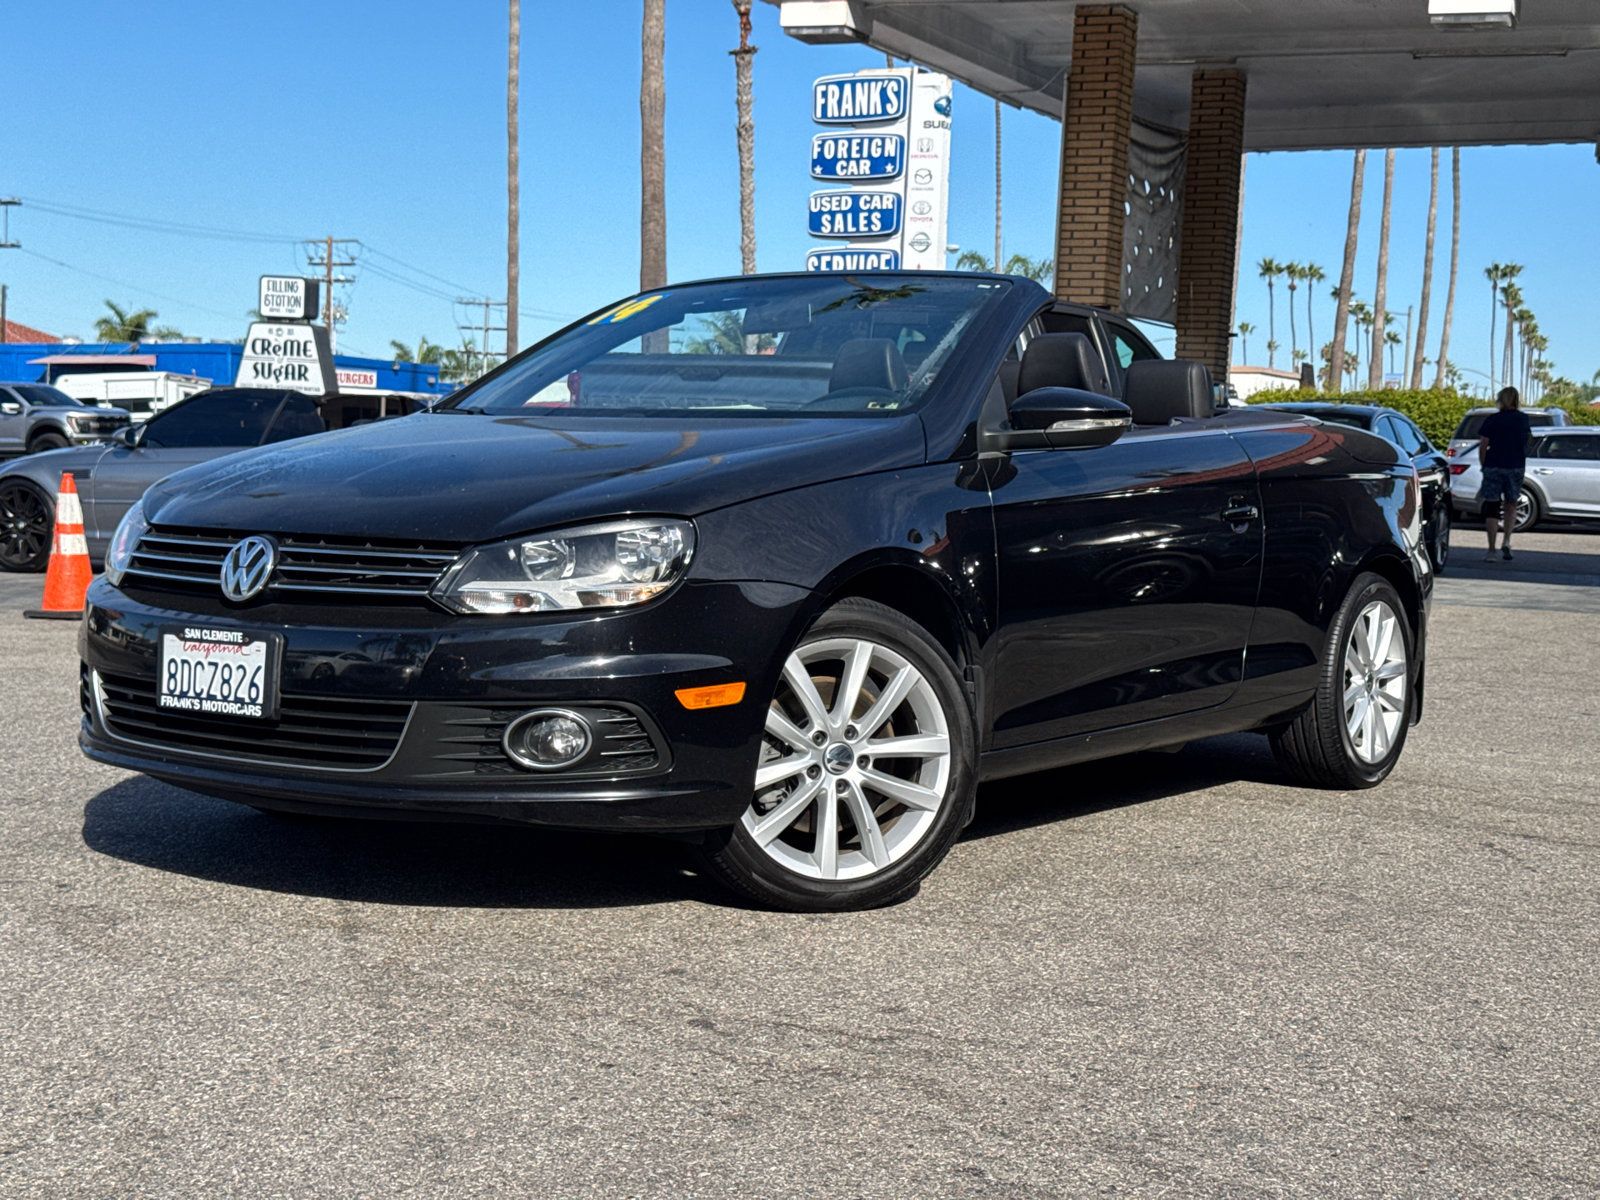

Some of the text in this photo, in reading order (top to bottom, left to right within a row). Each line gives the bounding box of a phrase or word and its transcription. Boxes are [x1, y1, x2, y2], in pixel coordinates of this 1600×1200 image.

[815, 80, 900, 119] FRANK'S
[812, 137, 896, 160] FOREIGN
[835, 159, 872, 176] CAR
[809, 195, 894, 213] USED CAR
[820, 211, 882, 234] SALES
[266, 279, 299, 293] FILLING
[184, 628, 243, 642] SAN CLEMENTE
[167, 658, 262, 704] 8DCZ826
[160, 695, 262, 716] FRANK'S MOTORCARS
